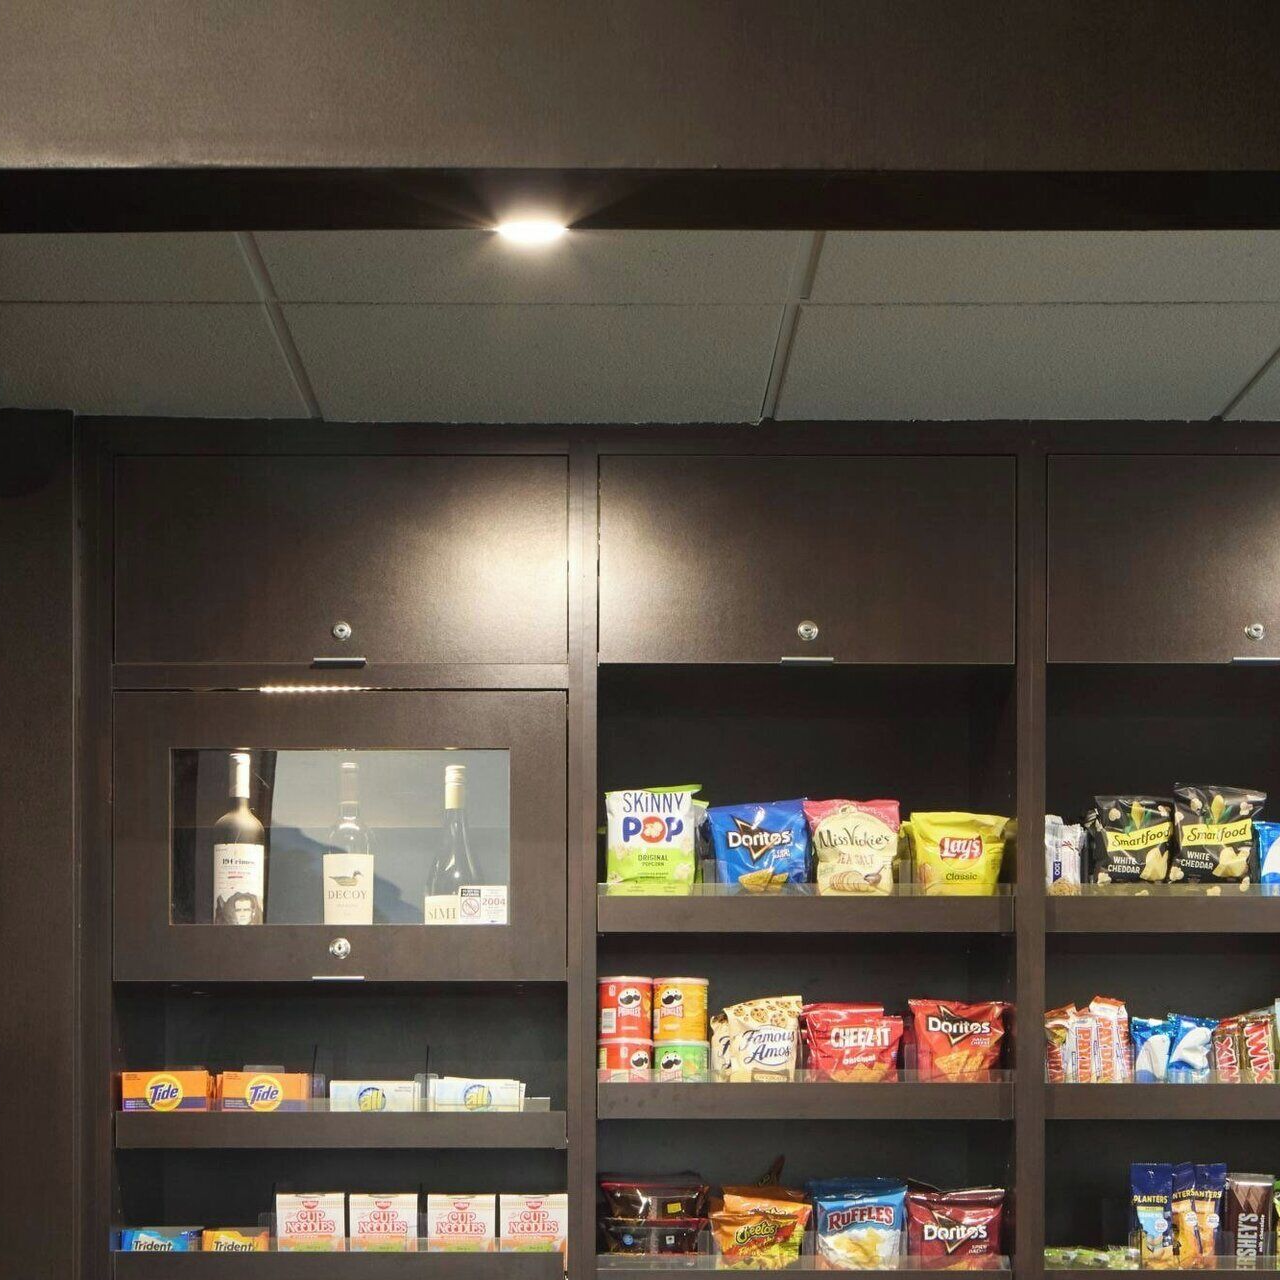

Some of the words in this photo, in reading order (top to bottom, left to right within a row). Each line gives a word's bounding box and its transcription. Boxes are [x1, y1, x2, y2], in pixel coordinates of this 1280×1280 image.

[622, 792, 683, 813] SKINNY
[622, 816, 683, 843] POP
[818, 829, 848, 849] Miss
[843, 824, 890, 851] Vickie's
[727, 830, 792, 848] Doritos
[940, 837, 981, 860] Lay's
[1186, 851, 1210, 861] WHITE
[1113, 856, 1136, 865] WHITE
[1180, 859, 1214, 870] CHEDDAR
[946, 873, 978, 881] Classic
[1108, 865, 1141, 874] CHEDDAR
[328, 890, 367, 899] DECOY
[927, 1016, 991, 1034] Doritos
[739, 1029, 795, 1050] Famous
[831, 1027, 891, 1048] CHEEZ-IT
[744, 1044, 791, 1064] Amos
[1077, 1028, 1092, 1083] PAYDA
[1215, 1036, 1241, 1084] WIX
[149, 1084, 179, 1105] Tide
[249, 1085, 279, 1105] Tide
[359, 1089, 383, 1112] all
[465, 1086, 490, 1110] all
[1133, 1194, 1168, 1204] PLANTERS
[1172, 1188, 1197, 1199] NTERS
[297, 1210, 325, 1222] CUP
[369, 1211, 398, 1223] CUP
[447, 1211, 476, 1223] CUP
[520, 1210, 549, 1222] CUP
[827, 1205, 894, 1232] RUFFLES
[285, 1220, 336, 1234] NOODLES
[358, 1221, 408, 1234] NOODLES
[435, 1221, 486, 1235] NOODLES
[508, 1221, 559, 1234] NOODLES
[735, 1220, 778, 1244] Cheetos
[923, 1223, 988, 1240] Doritos
[133, 1240, 172, 1250] Trident
[214, 1240, 253, 1251] Trident
[1236, 1212, 1259, 1270] ERSHEY'S
